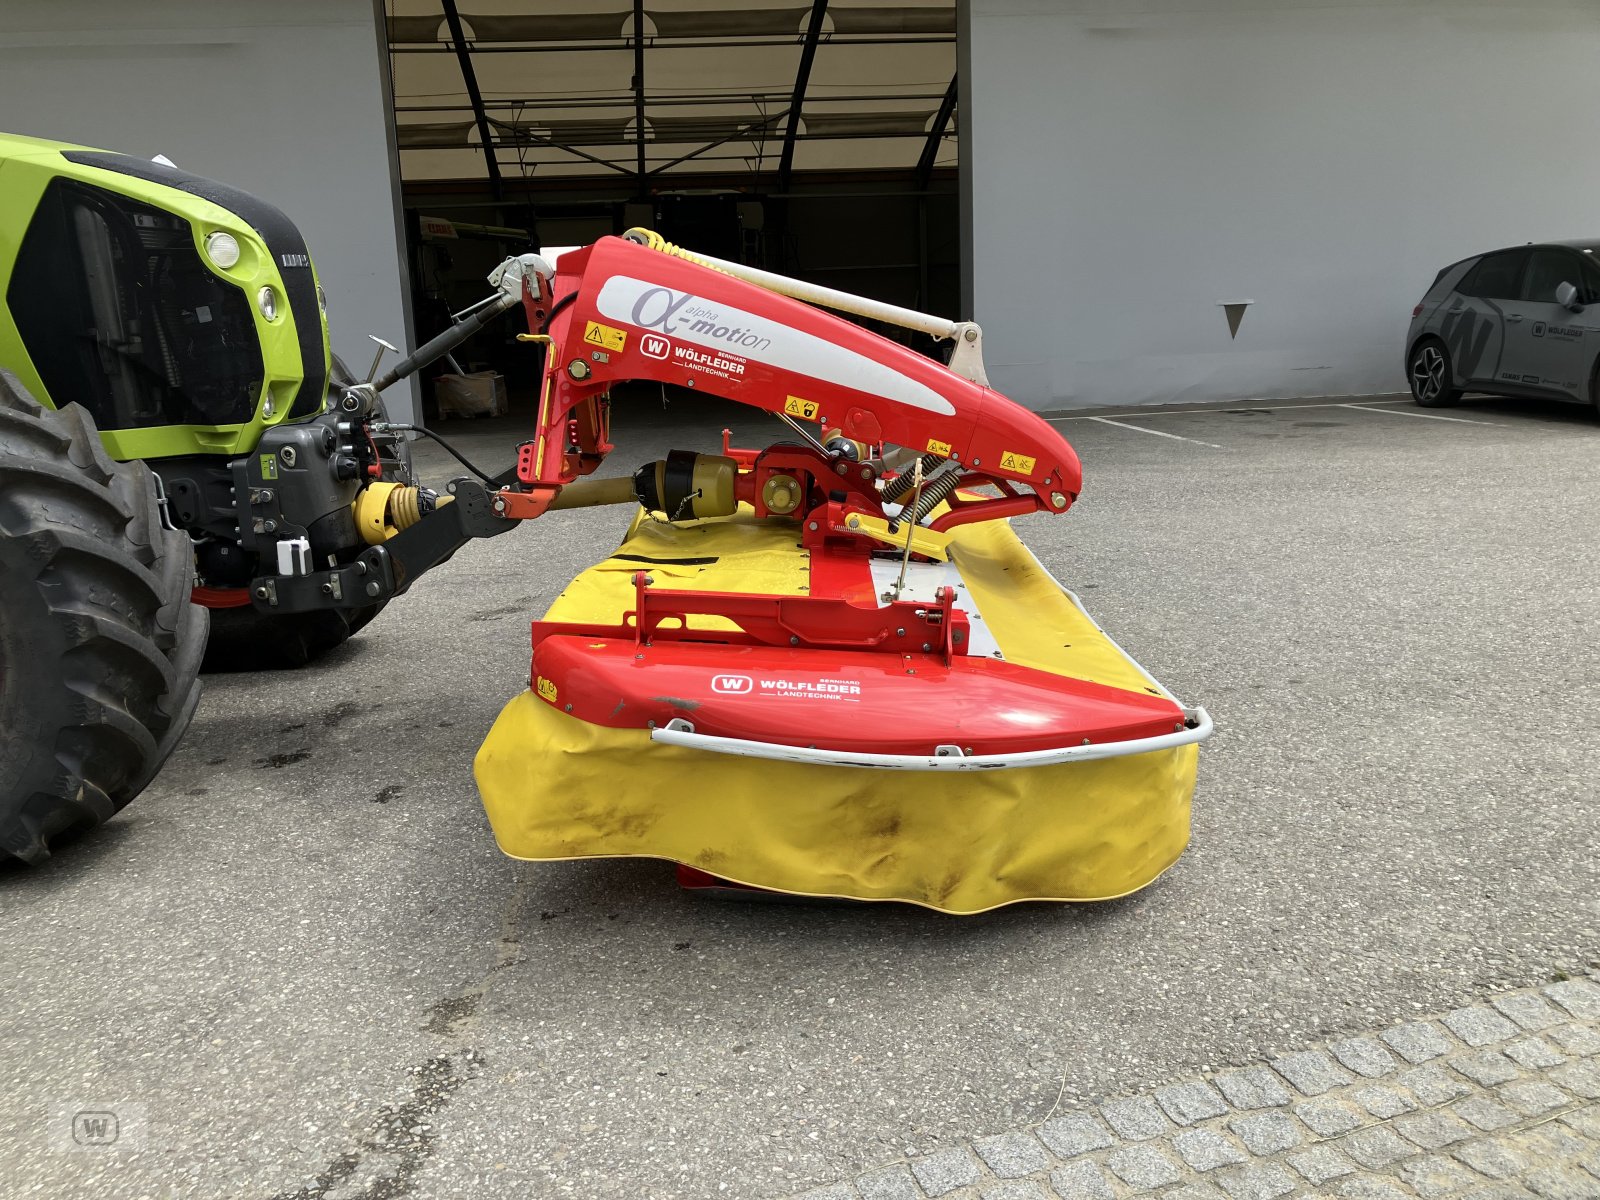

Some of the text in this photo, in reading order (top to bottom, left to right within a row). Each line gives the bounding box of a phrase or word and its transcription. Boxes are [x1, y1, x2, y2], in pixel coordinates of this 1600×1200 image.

[685, 305, 719, 321] alpha
[648, 339, 664, 355] W
[675, 346, 745, 375] WÖLFLEDER
[717, 351, 747, 364] BERNHARD
[684, 361, 729, 379] LANDTECHNIK
[721, 678, 743, 689] W
[760, 680, 861, 695] WÖLFLEDER
[777, 690, 842, 701] LANDTECHNIK
